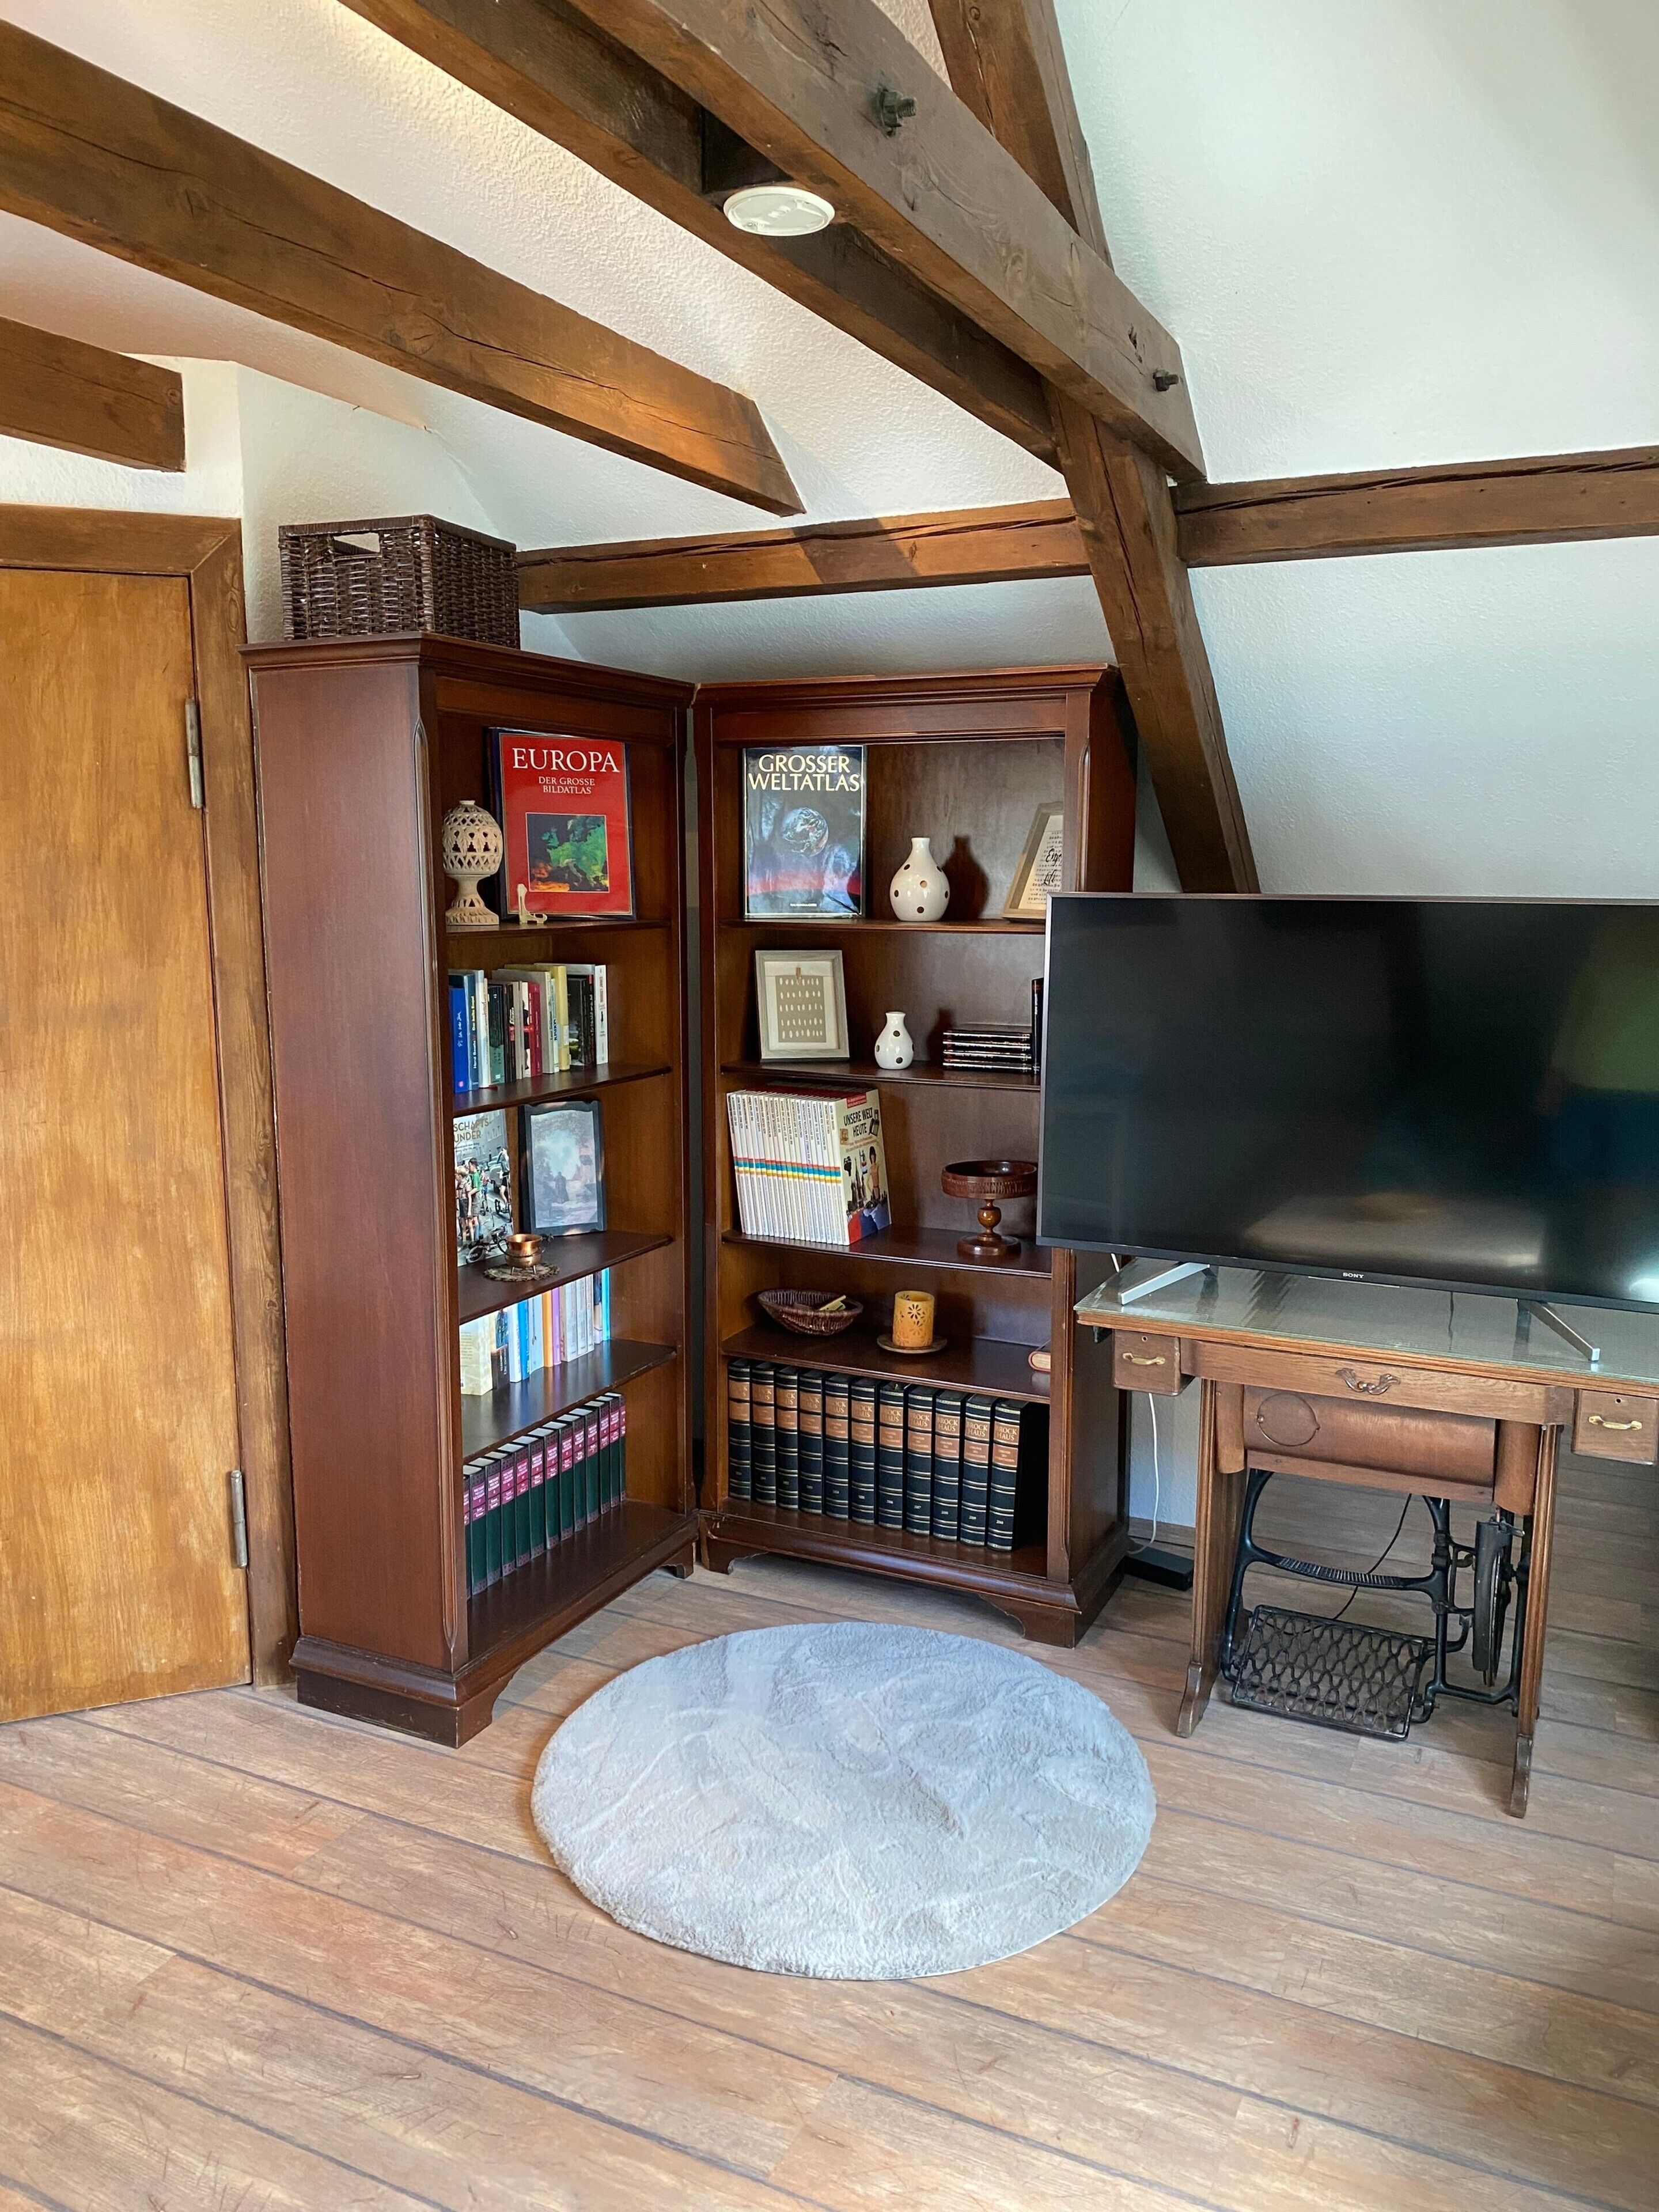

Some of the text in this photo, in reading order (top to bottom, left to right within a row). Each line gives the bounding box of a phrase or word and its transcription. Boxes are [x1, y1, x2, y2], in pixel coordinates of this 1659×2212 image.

[512, 747, 620, 773] EUROPA
[758, 753, 851, 774] GROSSER
[538, 776, 595, 786] DER GROSSE
[748, 772, 861, 792] WELTATLAS
[542, 785, 592, 794] BILDATLAS
[844, 1111, 862, 1126] UNSERE
[853, 1123, 868, 1137] HEUTE
[968, 1429, 986, 1437] HAUS
[997, 1432, 1016, 1441] HAUS
